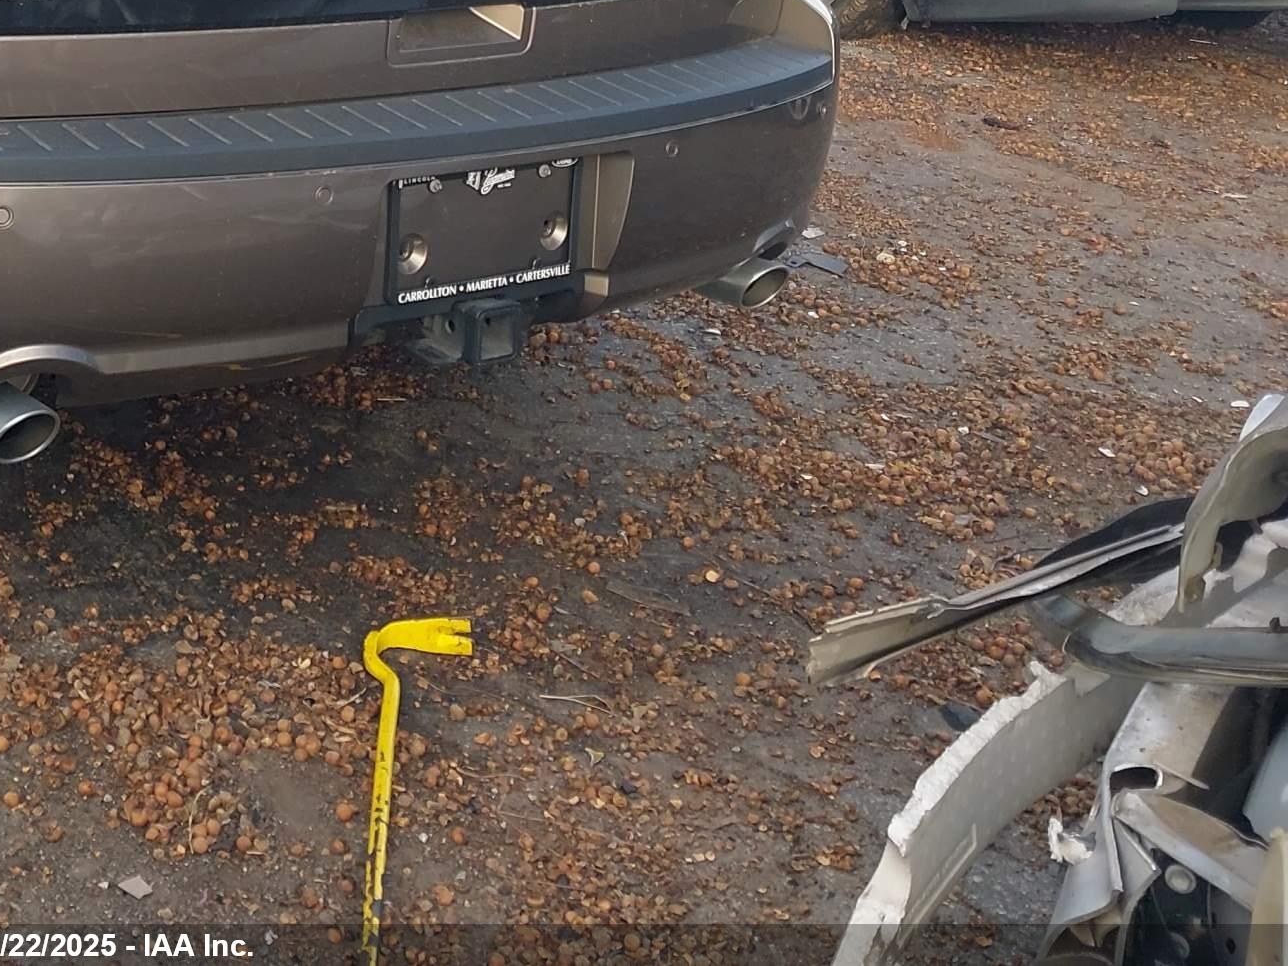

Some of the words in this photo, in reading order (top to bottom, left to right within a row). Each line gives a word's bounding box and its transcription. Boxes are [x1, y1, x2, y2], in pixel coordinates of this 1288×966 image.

[398, 285, 457, 304] CARROLLTON
[466, 277, 508, 293] MARIETTA
[516, 264, 570, 284] CARTERSVILLE
